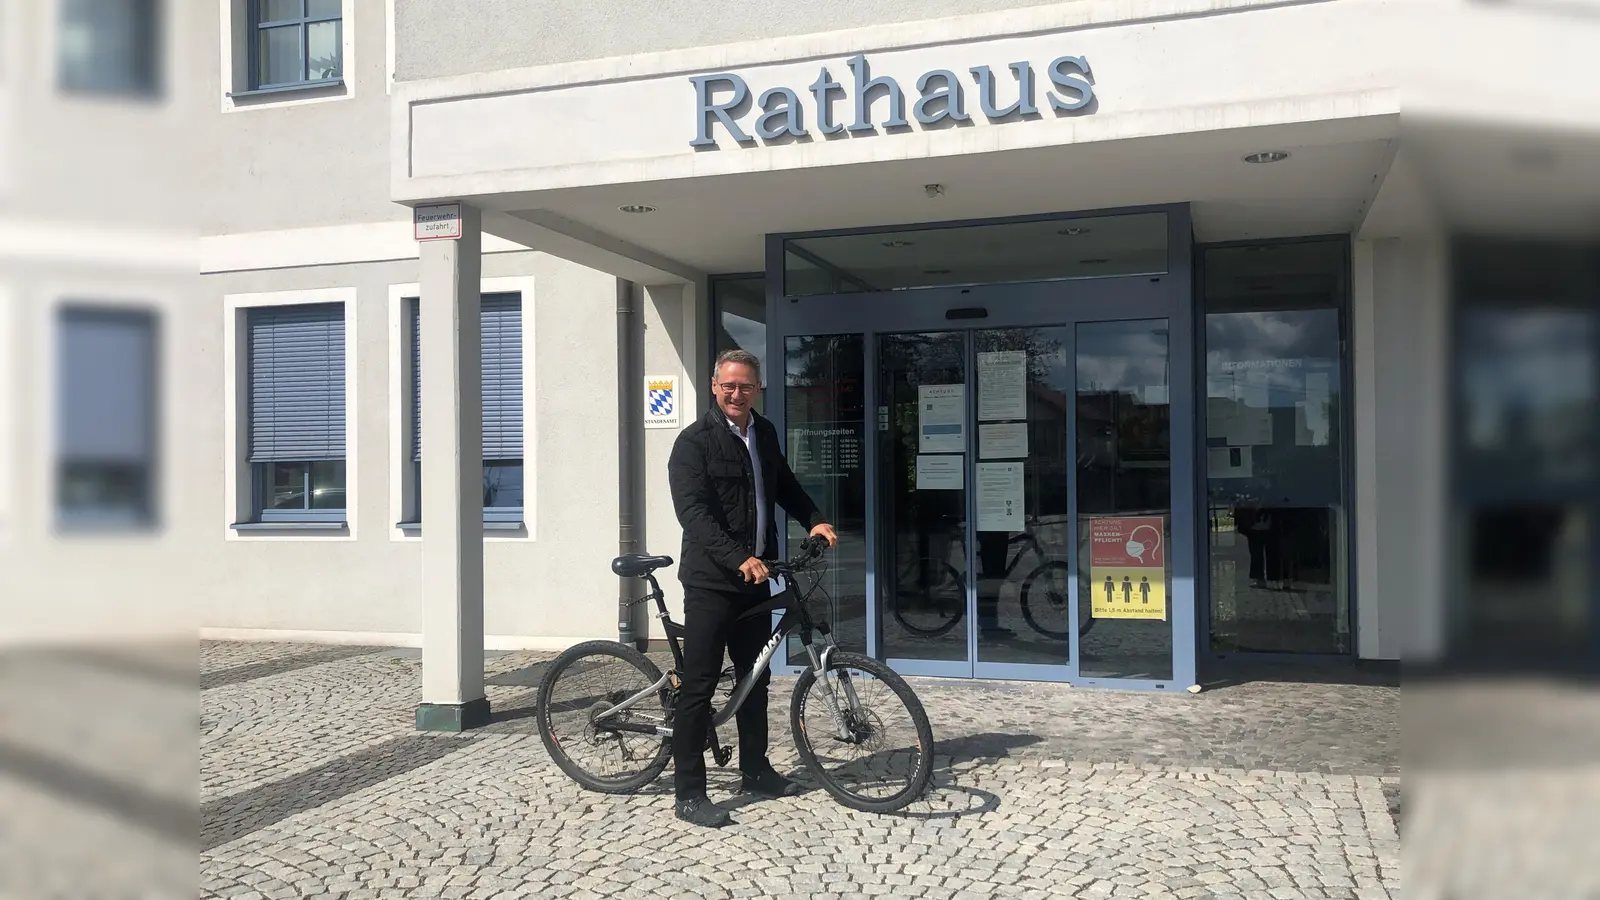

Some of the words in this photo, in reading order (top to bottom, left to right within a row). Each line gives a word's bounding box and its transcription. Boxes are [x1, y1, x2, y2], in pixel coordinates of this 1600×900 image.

[689, 54, 1095, 148] Rathaus
[417, 213, 457, 222] Feuerwehr-
[425, 223, 449, 231] zufahrt
[1221, 359, 1302, 370] INFORMATIONEN
